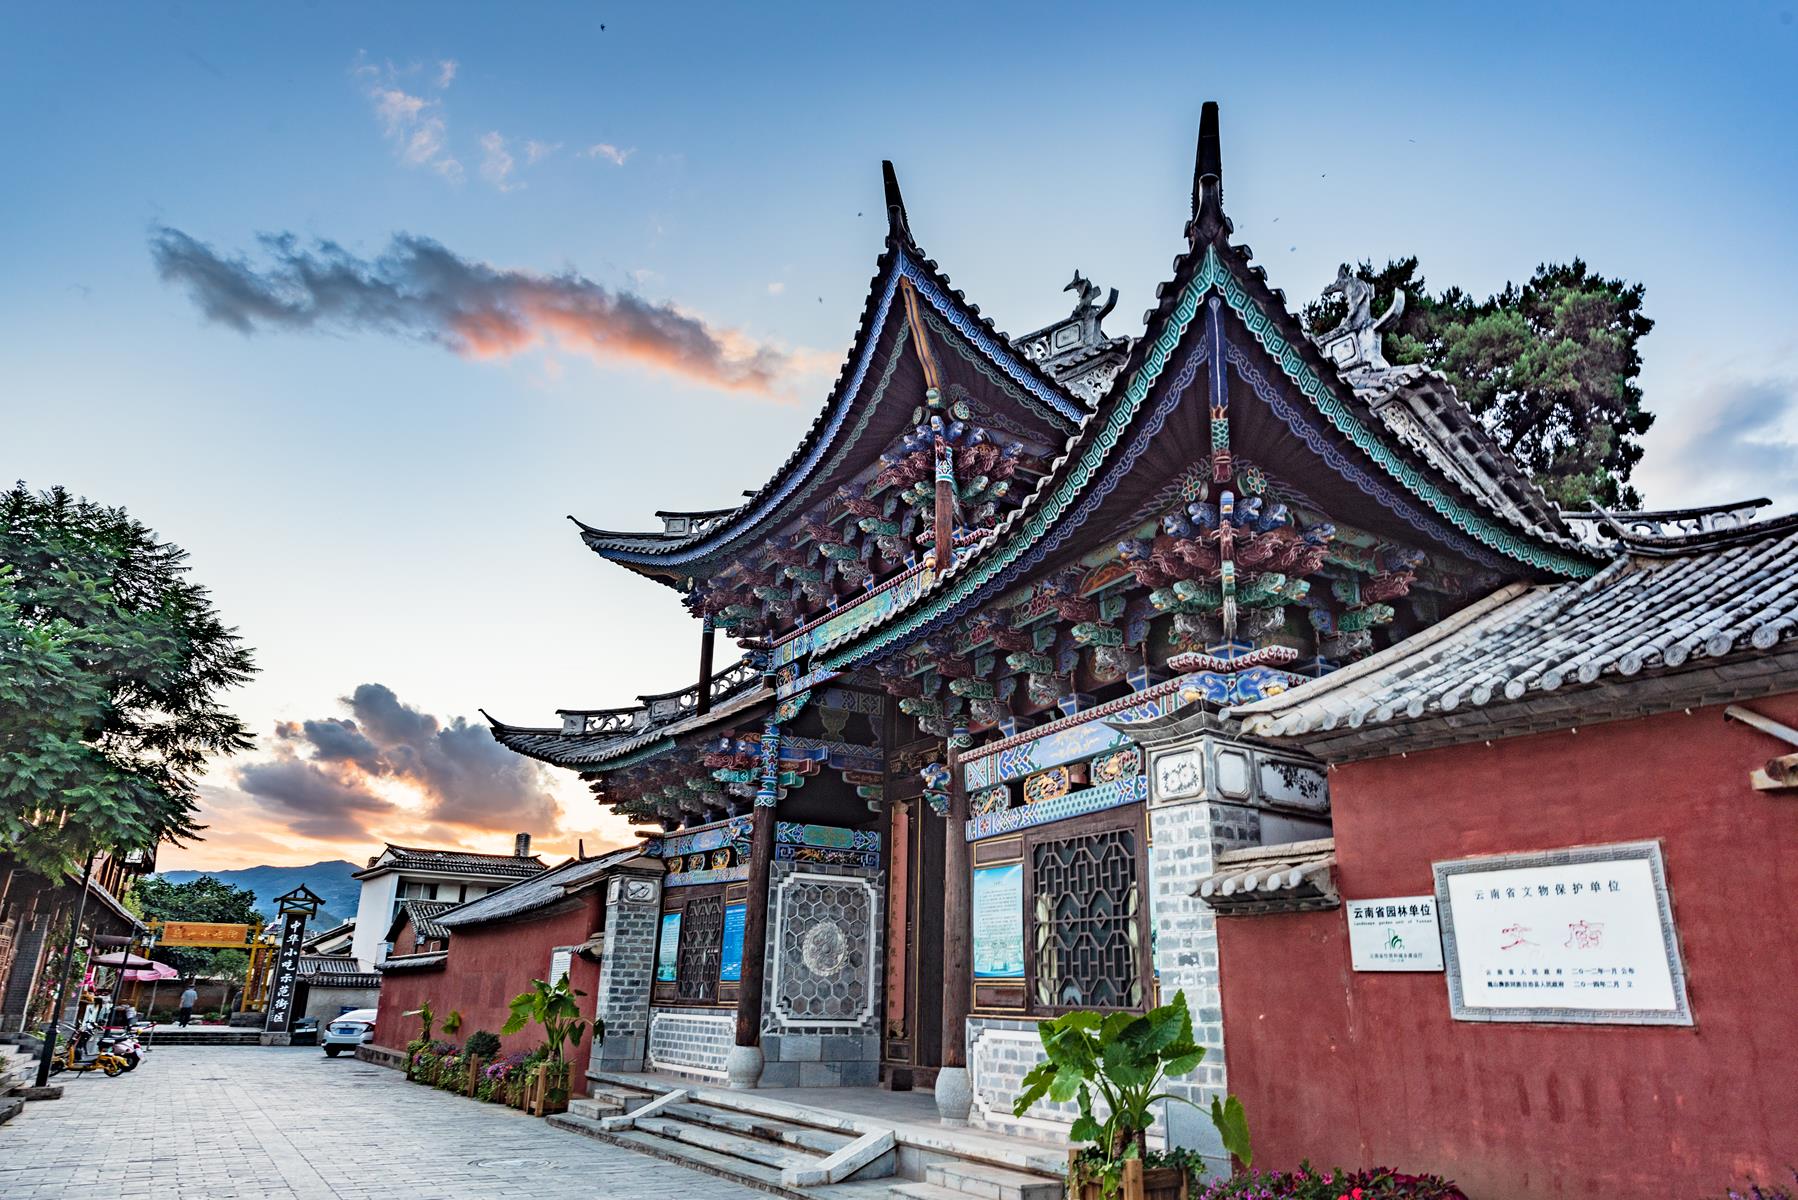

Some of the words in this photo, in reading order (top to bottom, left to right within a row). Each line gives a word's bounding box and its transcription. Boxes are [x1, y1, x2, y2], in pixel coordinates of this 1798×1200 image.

[1475, 880, 1620, 900] 云南省文物保护单位
[1353, 904, 1431, 919] 云南省园林单位
[273, 920, 301, 1022] 中华小吃示范街区
